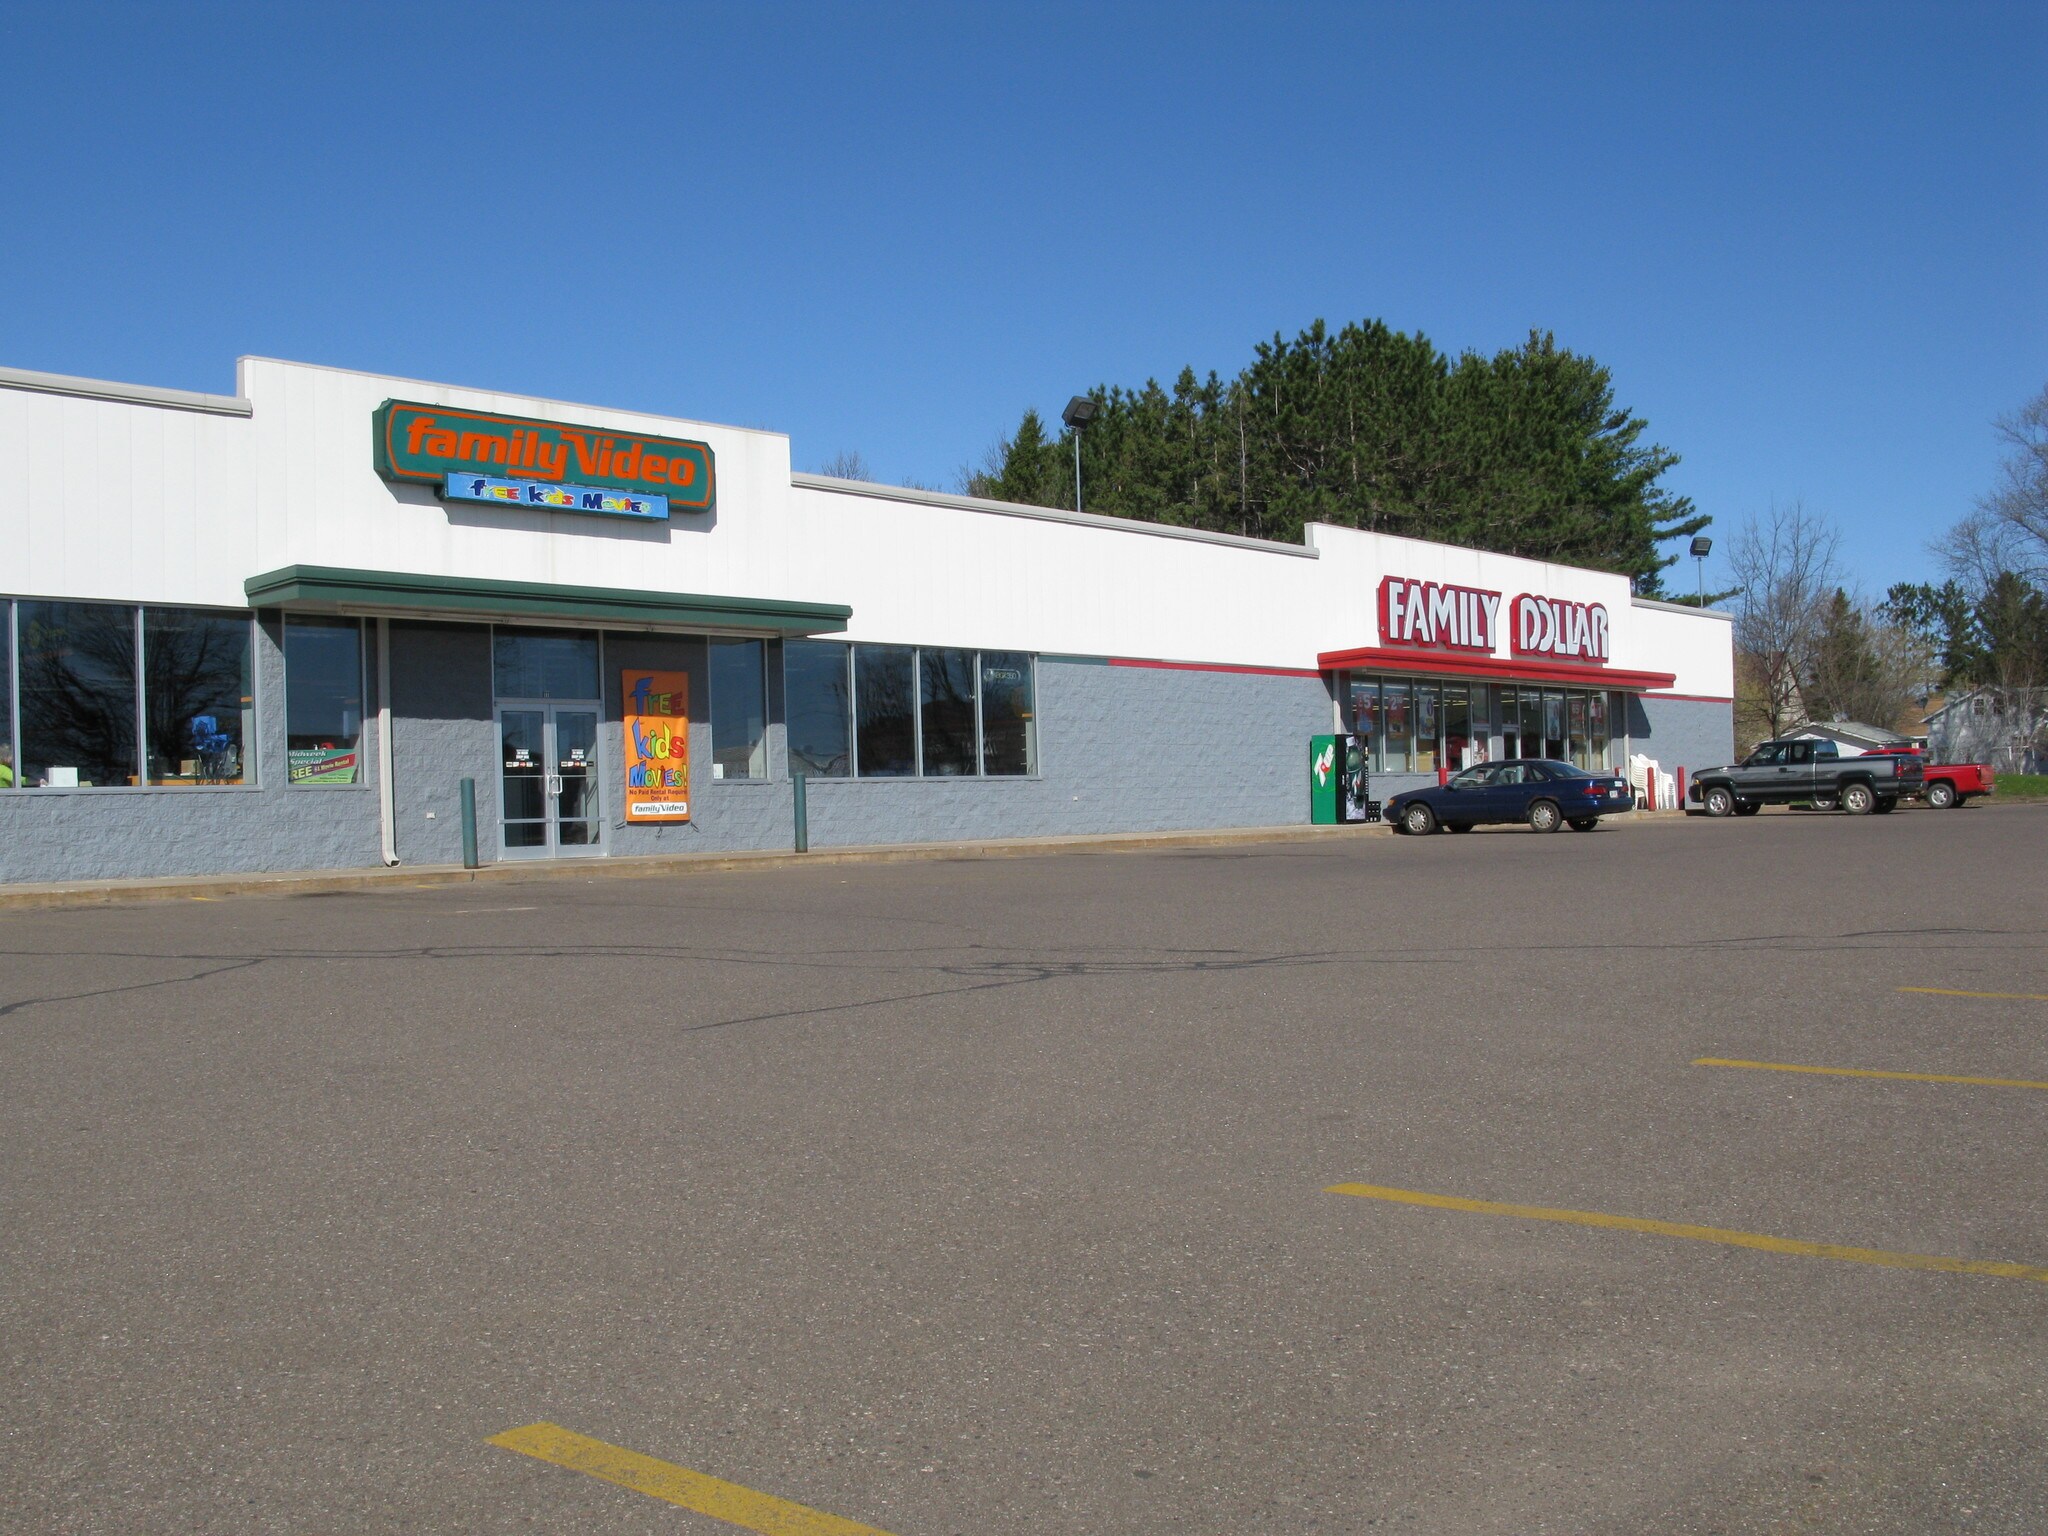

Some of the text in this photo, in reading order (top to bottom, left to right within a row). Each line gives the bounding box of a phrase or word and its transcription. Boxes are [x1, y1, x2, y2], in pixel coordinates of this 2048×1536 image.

[528, 484, 575, 506] kids
[1387, 579, 1609, 659] FAMILY DOLLAR
[632, 717, 685, 760] kids
[290, 758, 322, 766] Special
[290, 766, 312, 779] REE
